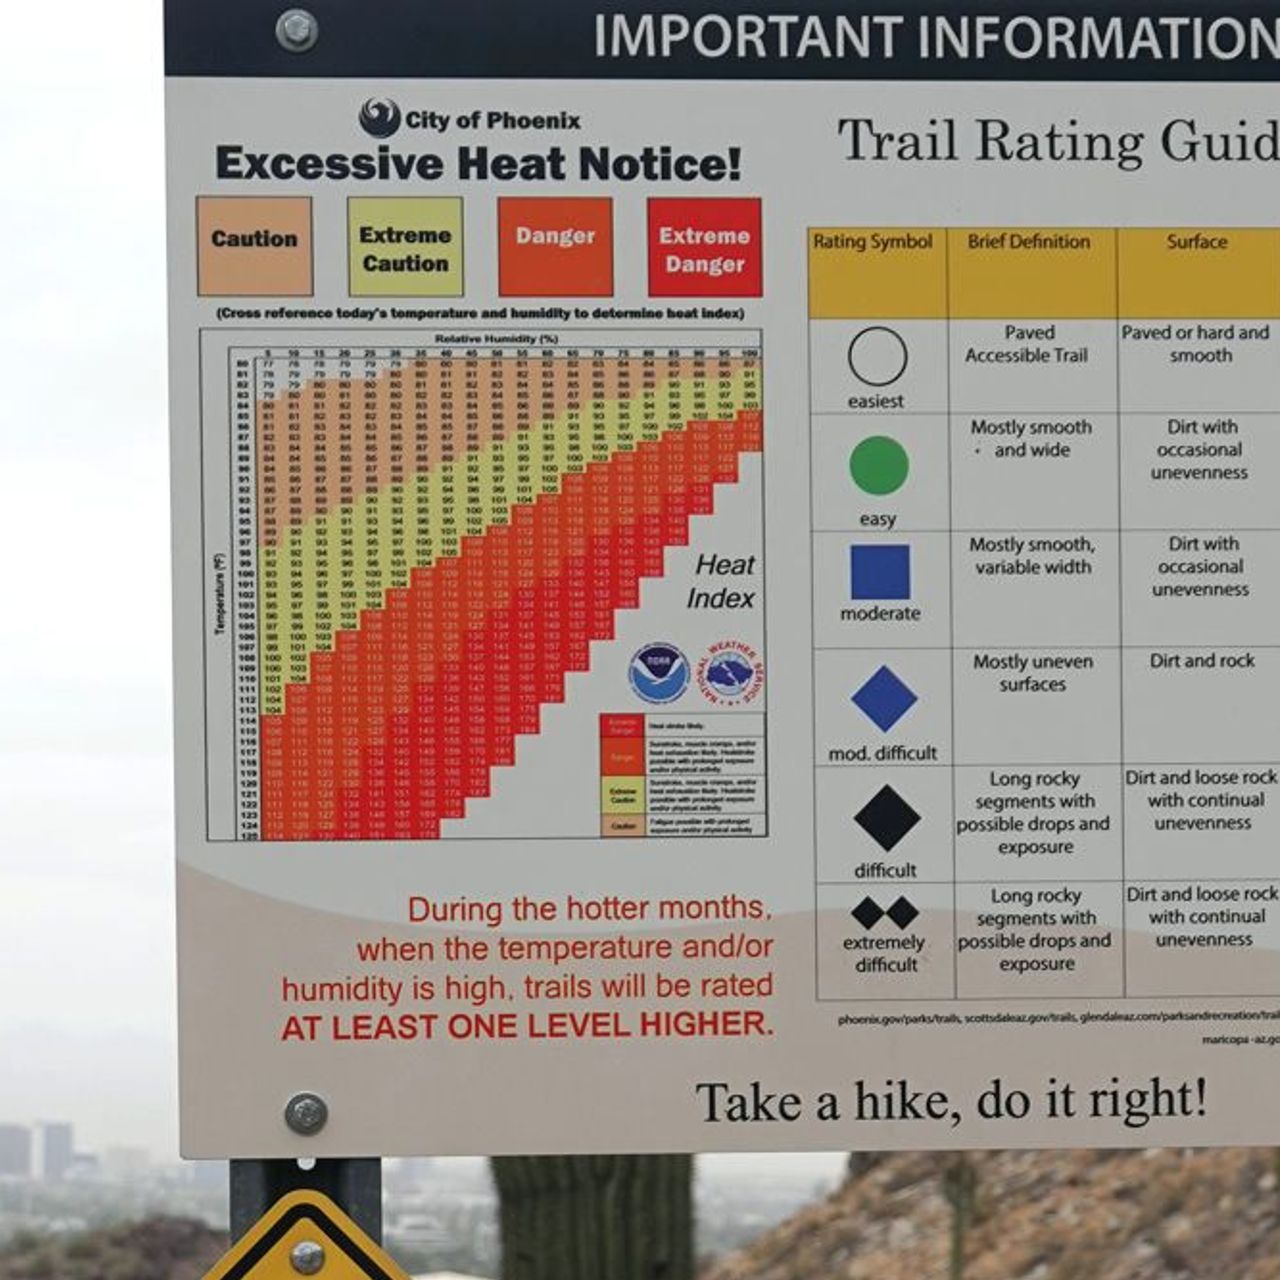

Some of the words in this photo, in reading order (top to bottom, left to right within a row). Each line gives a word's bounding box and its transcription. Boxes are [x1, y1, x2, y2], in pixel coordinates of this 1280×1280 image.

[595, 13, 904, 58] IMPORTANT
[405, 110, 451, 134] City
[455, 110, 482, 130] of
[486, 111, 581, 130] Phoenix
[837, 118, 959, 161] Trail
[975, 118, 1145, 172] Rating
[216, 144, 444, 181] Excessive
[458, 145, 567, 181] Heat
[579, 145, 741, 182] Notice!
[211, 229, 298, 248] Caution
[359, 226, 452, 244] Extreme
[515, 227, 596, 247] Danger
[659, 224, 751, 247] Extreme
[809, 233, 867, 253] Rating
[870, 232, 933, 253] Symbol
[968, 232, 1007, 249] Brief
[1006, 232, 1091, 250] Definition
[1167, 232, 1229, 250] Surface
[362, 254, 449, 272] Caution
[665, 255, 746, 275] Danger
[216, 306, 262, 321] (Cross
[264, 307, 334, 319] reference
[335, 307, 388, 322] today's
[390, 307, 478, 322] temperature
[480, 307, 508, 319] and
[510, 307, 572, 322] humidity
[573, 307, 590, 319] to
[591, 307, 664, 320] determine
[666, 307, 699, 319] heat
[701, 307, 745, 321] index)
[435, 334, 482, 345] Relative
[484, 334, 537, 345] Humidity
[539, 334, 559, 345] (%)
[1005, 324, 1056, 341] Paved
[1121, 324, 1172, 340] Paved
[1175, 328, 1194, 341] or
[1196, 324, 1235, 341] hard
[1238, 324, 1270, 340] and
[964, 347, 1051, 364] Accessible
[1053, 347, 1089, 363] Trail
[1170, 347, 1233, 364] smooth
[847, 393, 904, 409] easiest
[970, 419, 1026, 439] Mostly
[1029, 419, 1093, 435] smooth
[1167, 418, 1198, 435] Dirt
[1202, 418, 1239, 434] with
[994, 442, 1027, 458] and
[1030, 441, 1071, 458] wide
[1156, 441, 1243, 458] occasional
[1150, 468, 1249, 480] unevenness
[859, 514, 897, 530] easy
[695, 553, 756, 576] Heat
[975, 558, 1041, 575] variable
[1044, 558, 1092, 575] width
[687, 587, 756, 610] Index
[840, 605, 922, 622] moderate
[973, 653, 1029, 673] Mostly
[1032, 656, 1094, 670] uneven
[1150, 652, 1181, 669] Dirt
[1184, 652, 1216, 669] and
[1219, 652, 1256, 668] rock
[695, 656, 718, 704] NATIONAL
[708, 640, 758, 660] WEATHER
[742, 662, 764, 704] SERVICE
[999, 675, 1067, 693] surfaces
[828, 745, 871, 762] mod.
[874, 744, 937, 762] difficult
[854, 862, 917, 879] difficult
[409, 896, 503, 929] During
[511, 896, 557, 922] the
[567, 895, 650, 921] hotter
[659, 893, 772, 921] months,
[356, 936, 434, 962] when
[443, 935, 489, 962] the
[498, 935, 673, 966] temperature
[682, 933, 775, 959] and/or
[843, 934, 926, 954] extremely
[855, 956, 918, 973] difficult
[282, 975, 403, 1007] humidity
[413, 975, 435, 1001] is
[445, 974, 514, 1007] high,
[524, 973, 592, 1000] trails
[601, 972, 646, 998] will
[656, 972, 691, 998] be
[701, 971, 773, 998] rated
[281, 1015, 323, 1041] AT
[332, 1013, 439, 1041] LEAST
[447, 1013, 518, 1040] ONE
[528, 1011, 632, 1039] LEVEL
[640, 1010, 774, 1037] HIGHER.
[695, 1081, 802, 1123] Take
[816, 1092, 841, 1121] a
[855, 1079, 962, 1128] hike,
[977, 1078, 1031, 1119] do
[1047, 1077, 1076, 1118] it
[1089, 1076, 1206, 1129] right!
